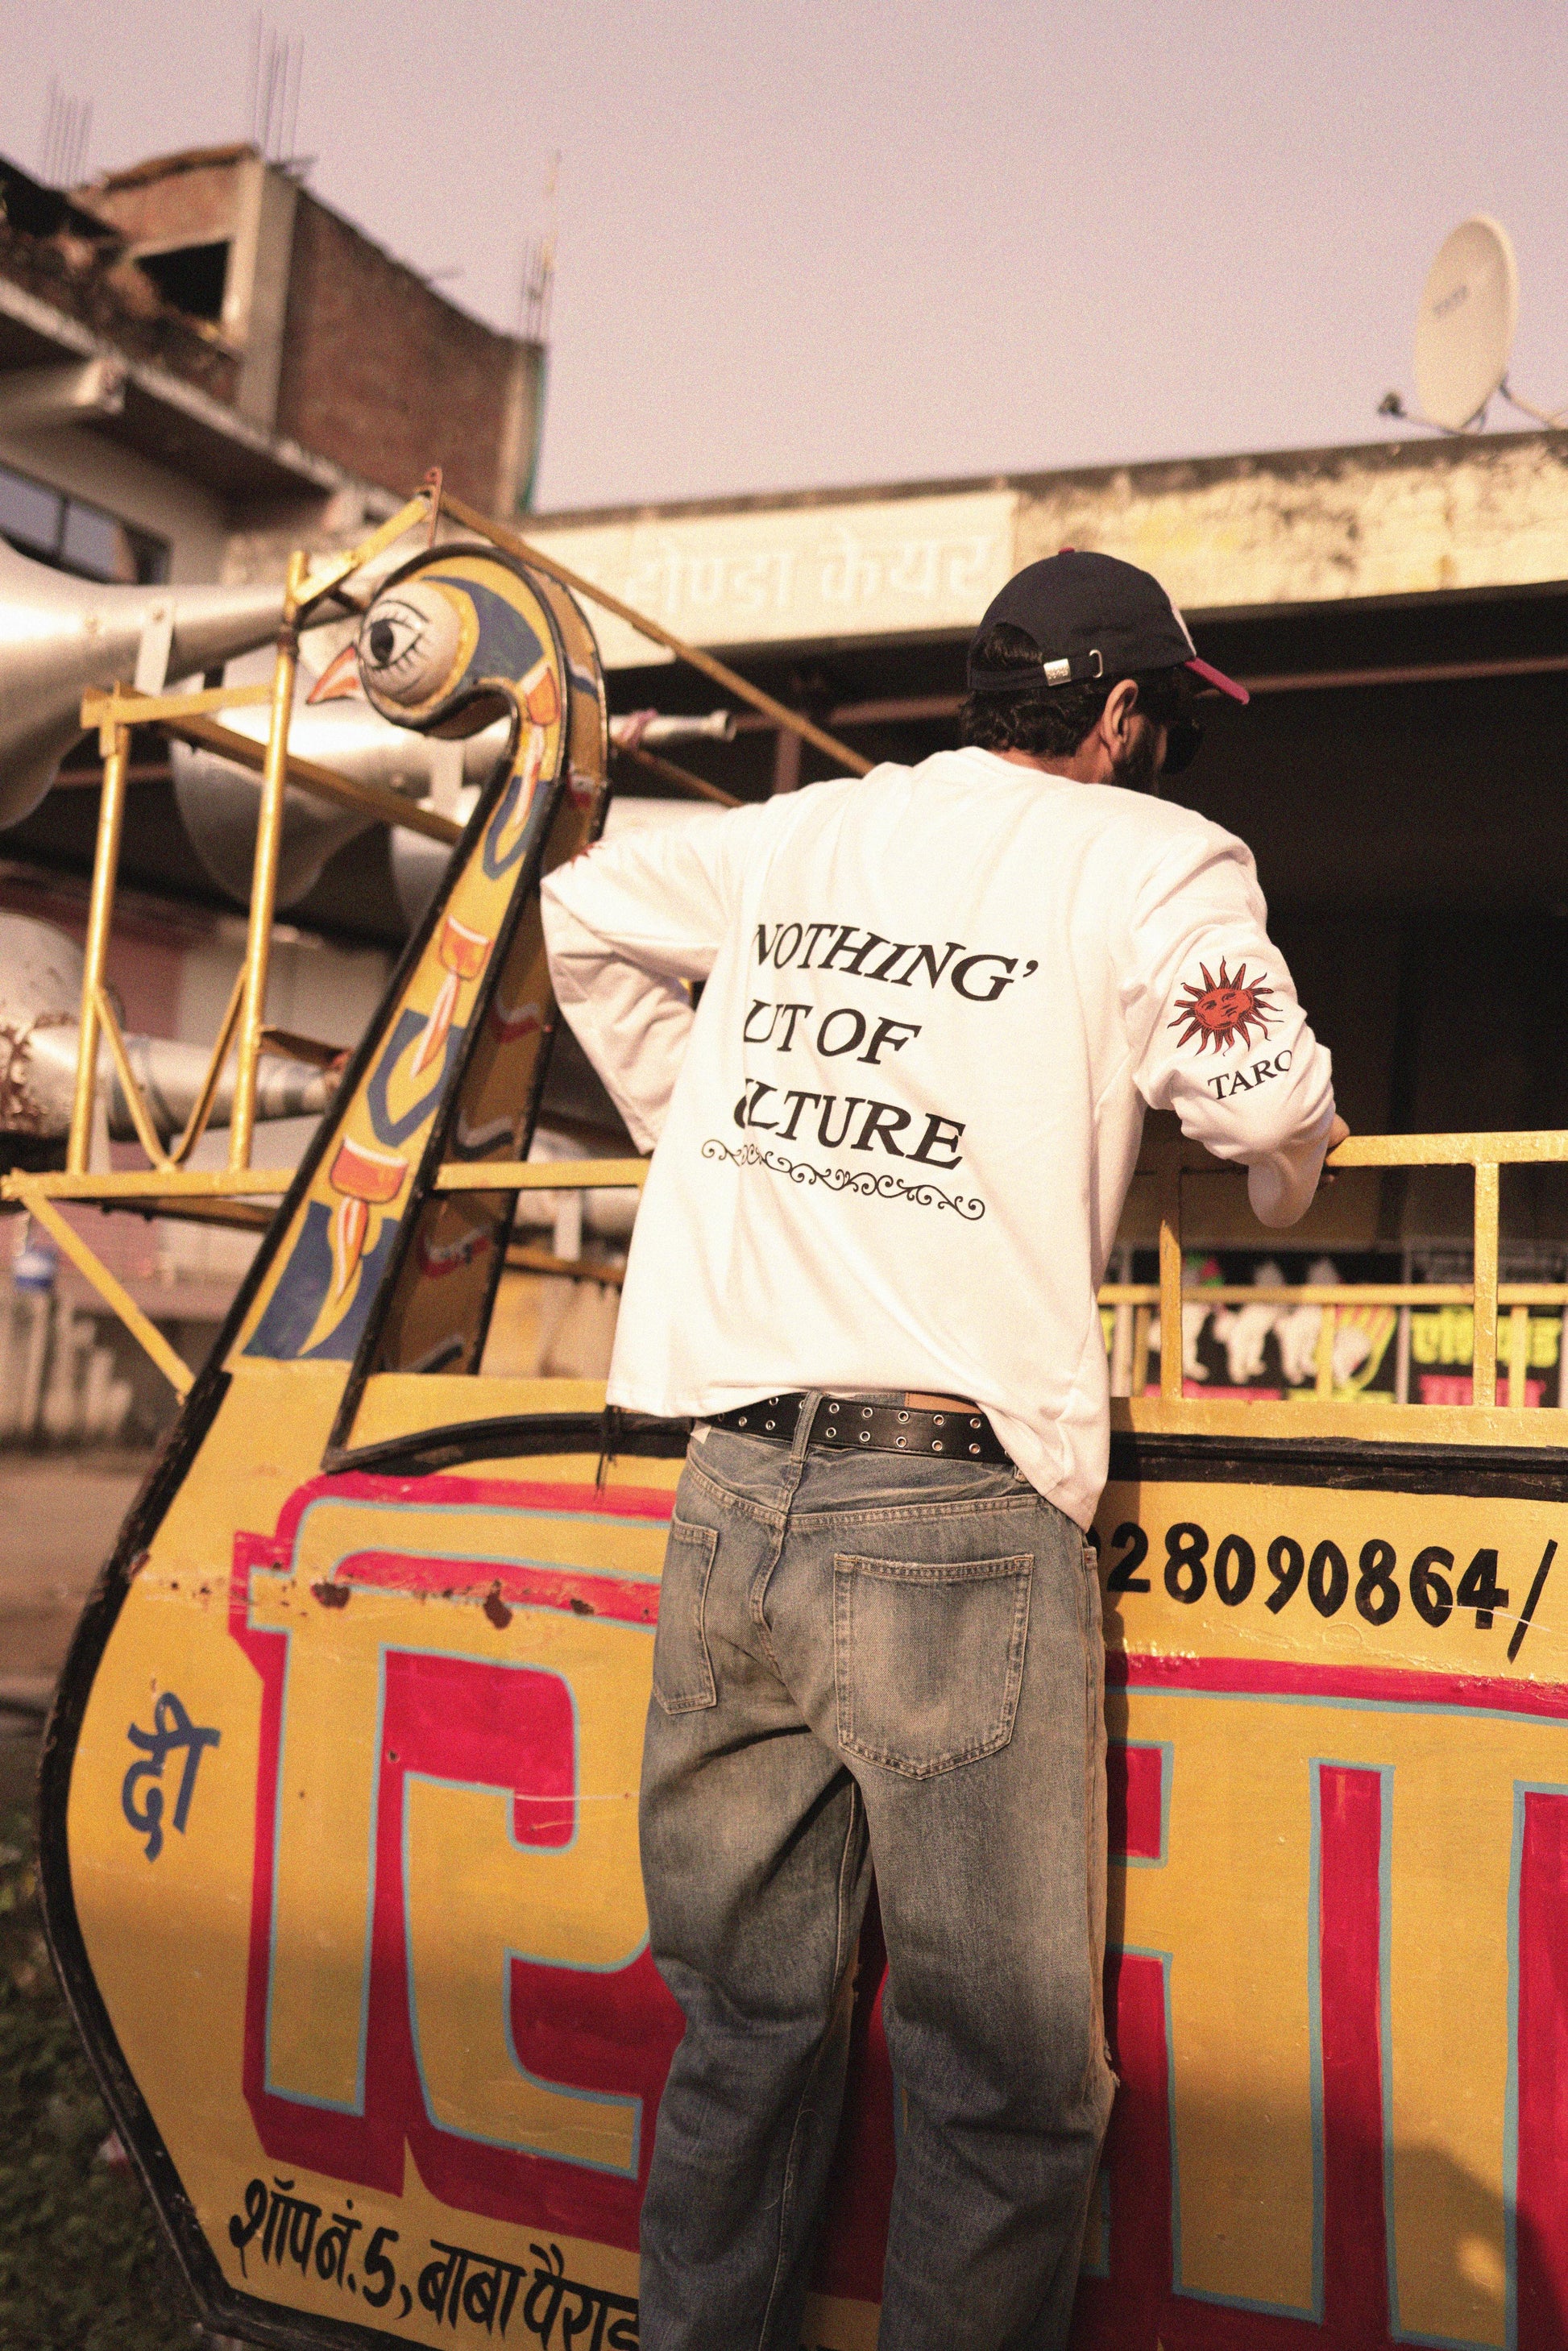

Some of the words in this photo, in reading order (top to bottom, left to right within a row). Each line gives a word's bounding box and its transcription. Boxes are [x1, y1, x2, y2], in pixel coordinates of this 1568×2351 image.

[816, 1007, 923, 1065] OF
[733, 1077, 967, 1171] LTURE
[1085, 1521, 1559, 1665] 28090864/
[417, 2238, 528, 2340] बाबा
